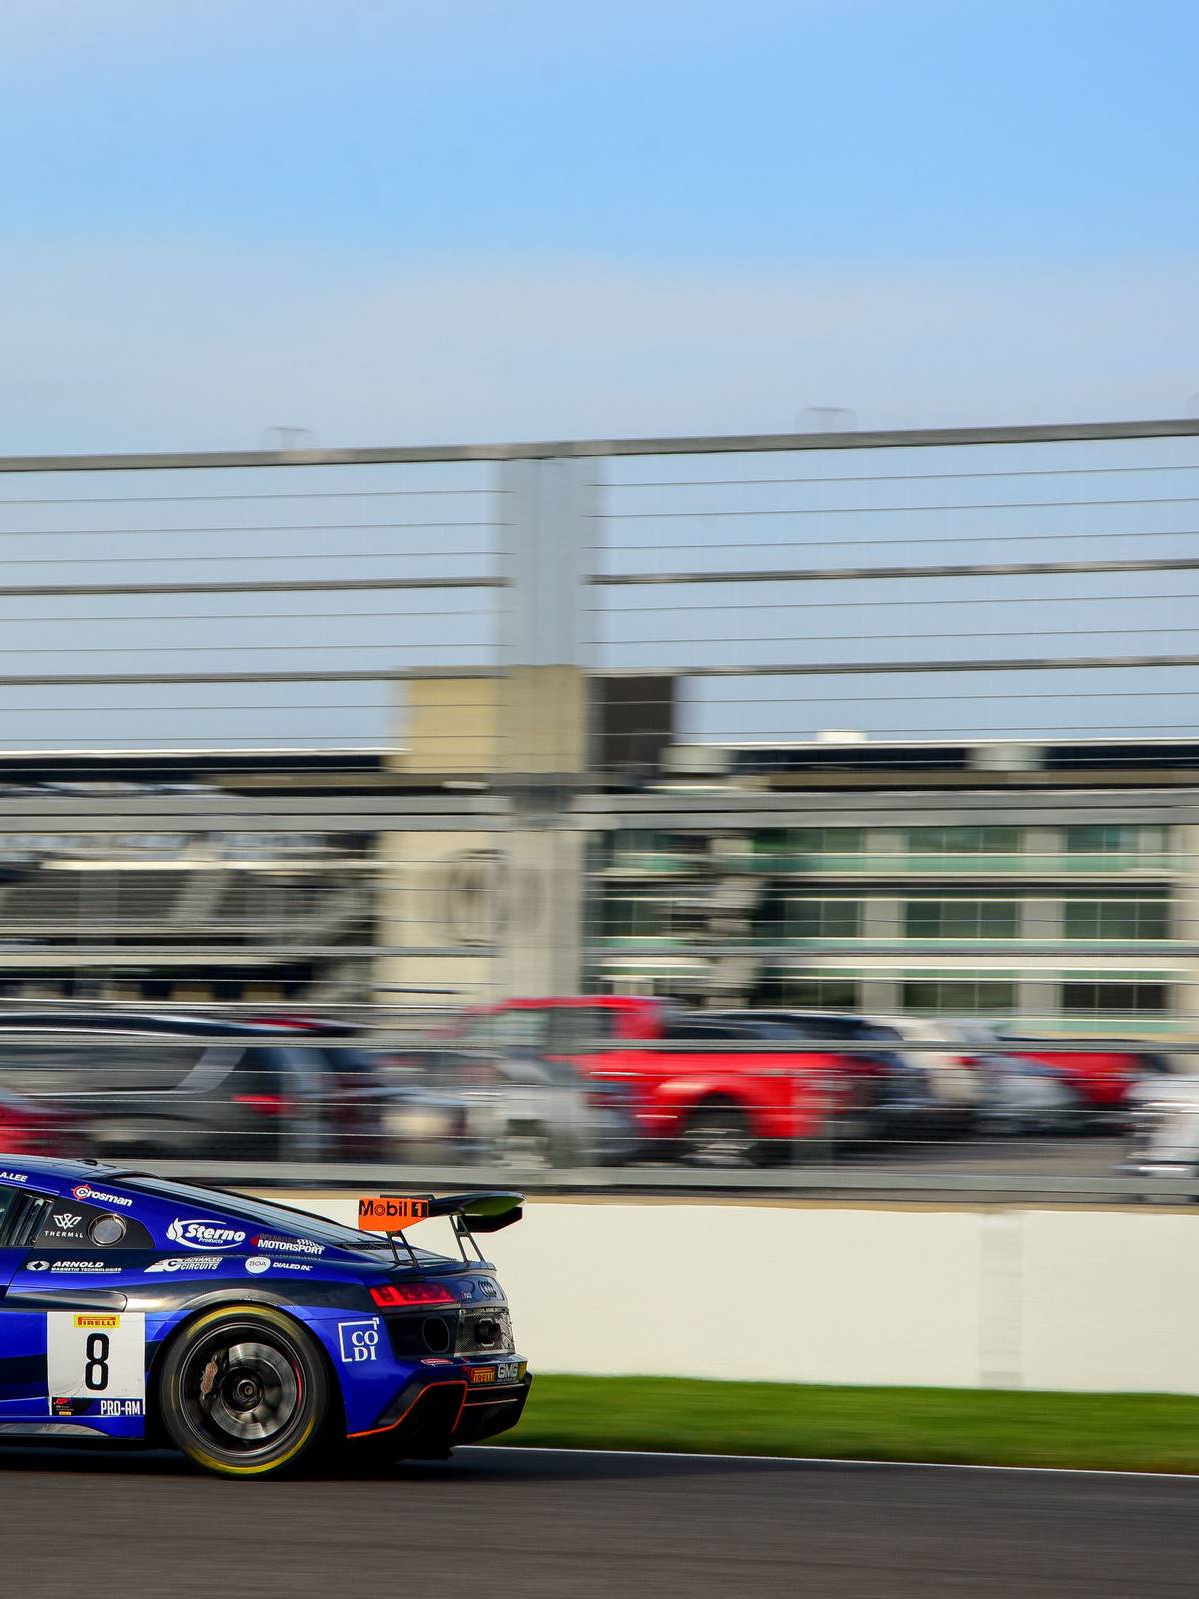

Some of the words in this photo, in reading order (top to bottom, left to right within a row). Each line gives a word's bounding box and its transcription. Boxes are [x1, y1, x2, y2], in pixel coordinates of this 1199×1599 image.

[0, 1171, 29, 1183] A.LEE
[75, 1187, 133, 1207] Crosman
[359, 1200, 408, 1217] Mobil
[184, 1223, 246, 1242] Sterno
[257, 1239, 324, 1255] MOTORSPORT
[180, 1263, 219, 1271] CIRCUITS
[77, 1316, 117, 1326] PIRELLI
[351, 1330, 379, 1346] CO
[85, 1332, 110, 1391] 8
[353, 1346, 377, 1362] DI
[100, 1400, 141, 1416] PRO-AM
